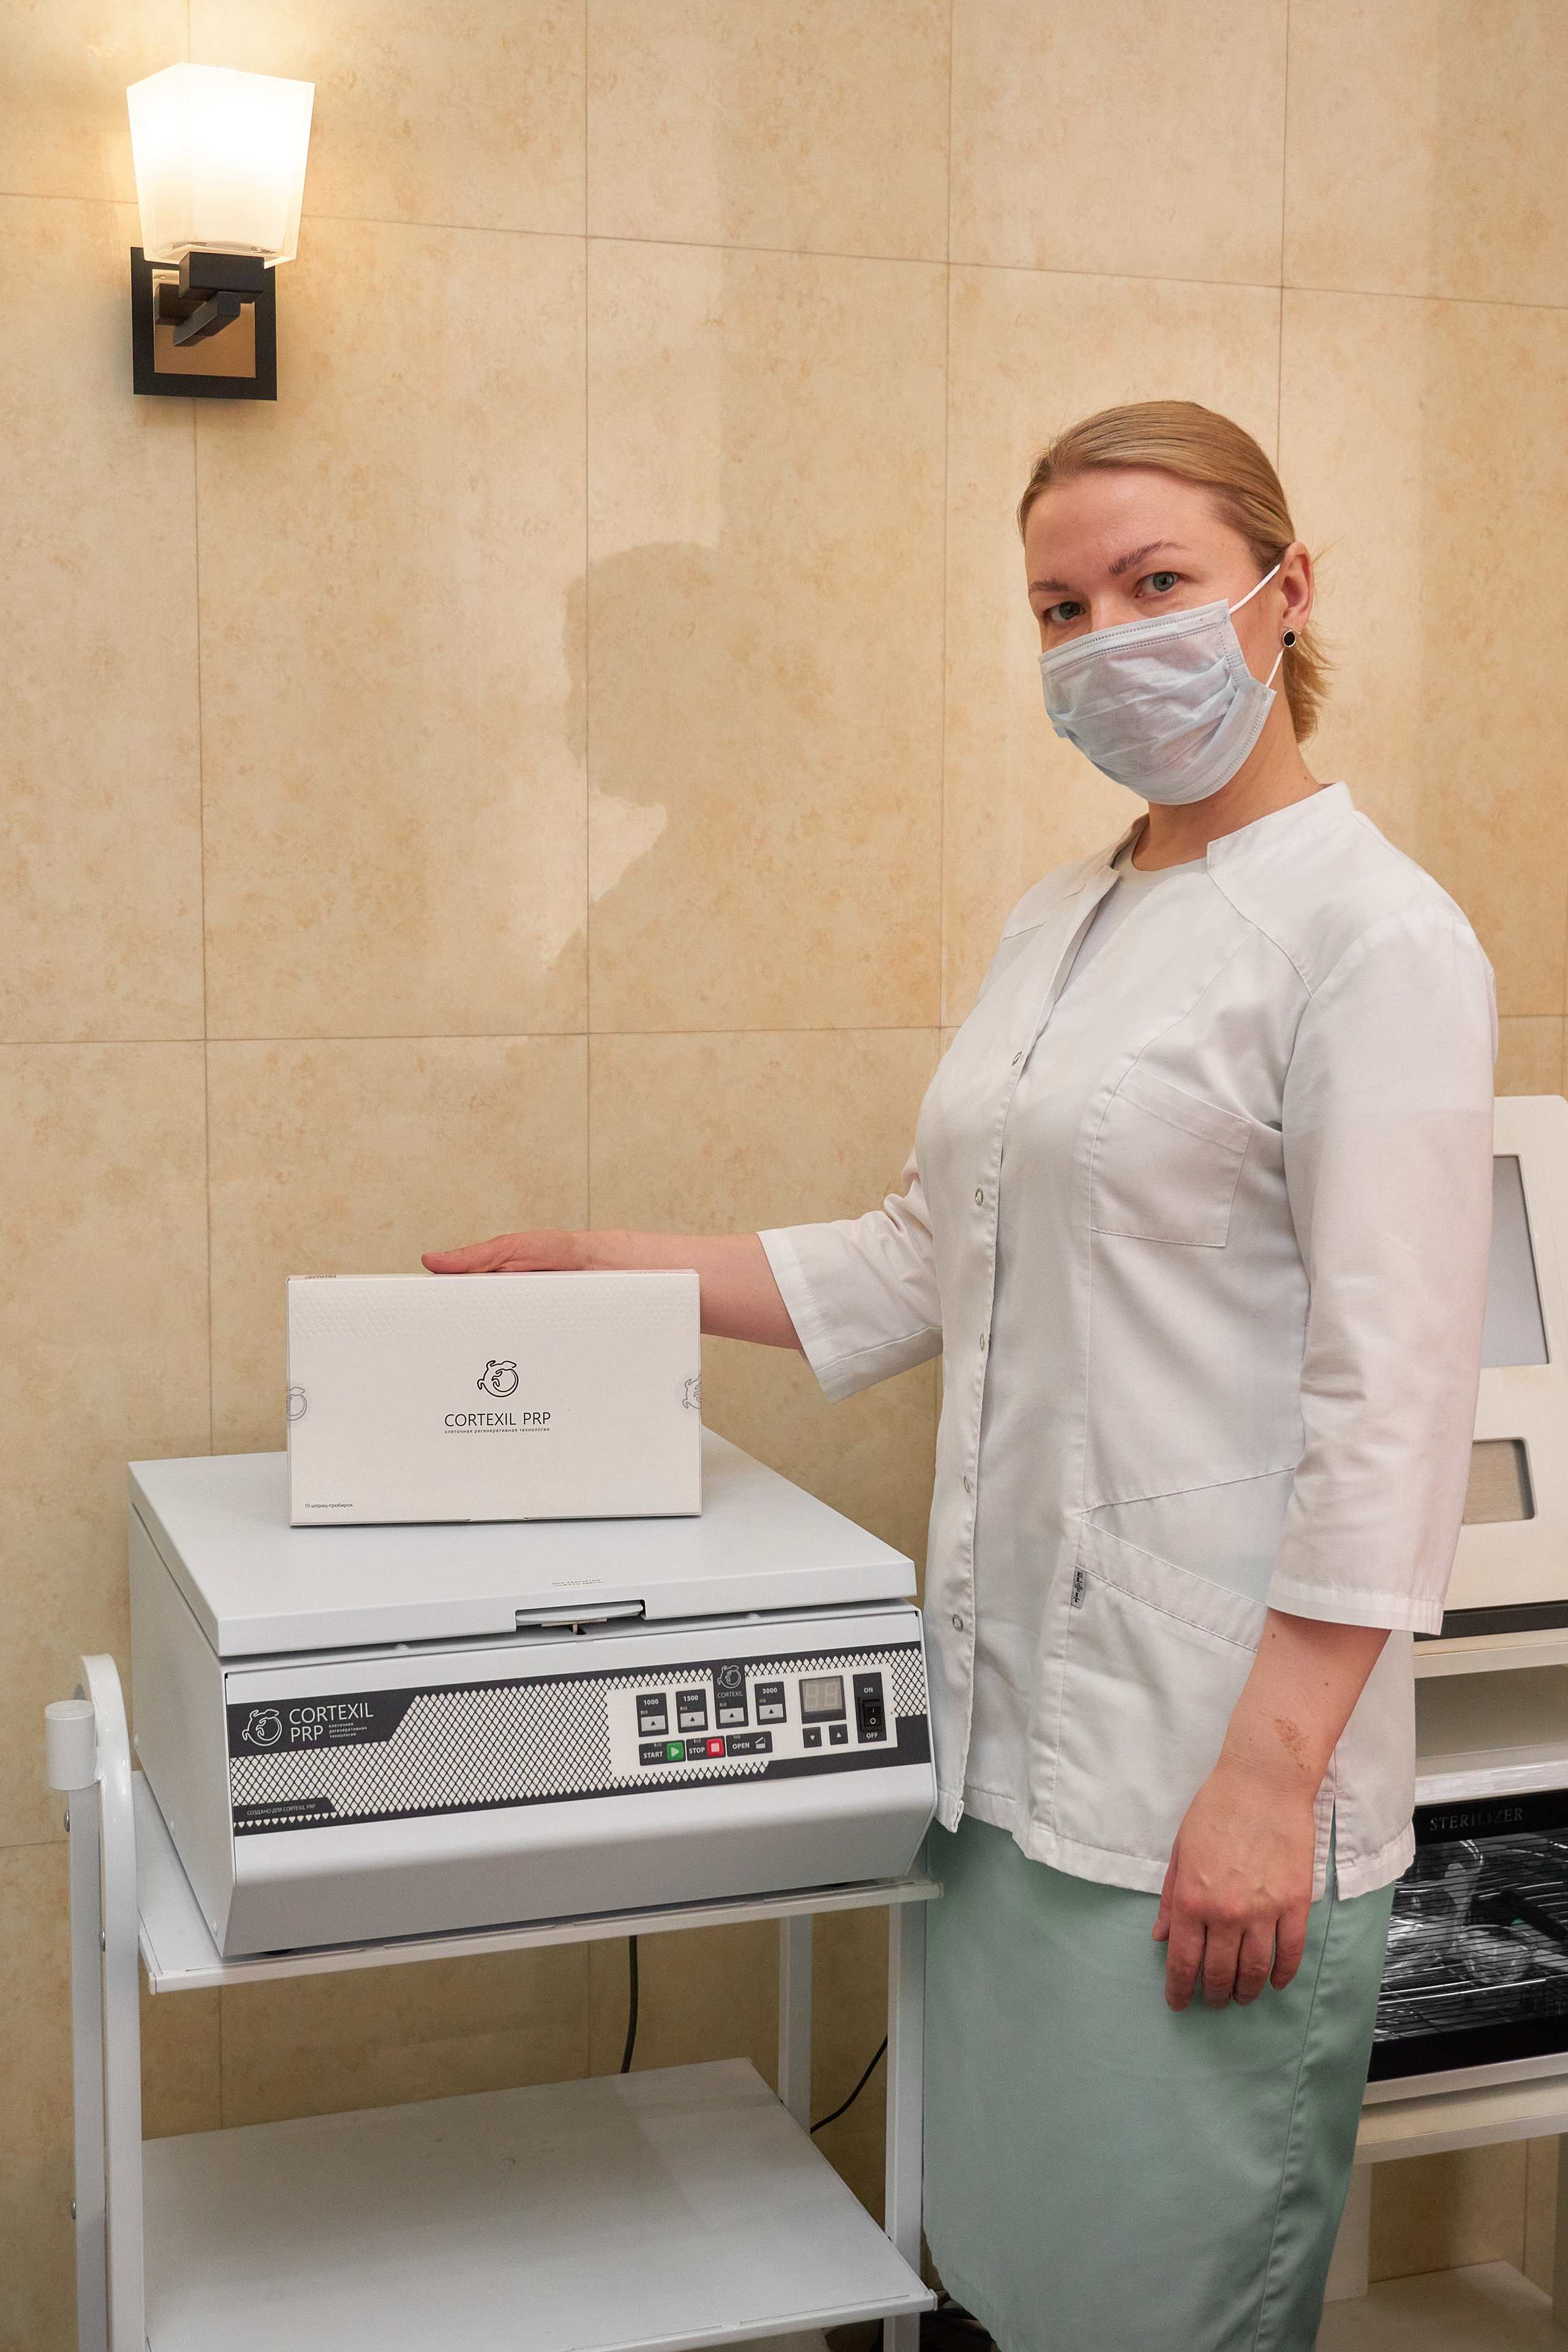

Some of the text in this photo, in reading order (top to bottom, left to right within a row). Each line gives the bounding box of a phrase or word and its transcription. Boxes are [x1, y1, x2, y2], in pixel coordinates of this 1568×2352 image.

[444, 1412, 551, 1427] CORTEXIL PRP
[717, 1691, 744, 1699] CORTEXIL
[289, 1702, 374, 1725] CORTEXIL
[290, 1725, 323, 1743] PRP
[732, 1741, 750, 1750] OPEN
[643, 1751, 663, 1759] START
[1430, 1807, 1524, 1831] STERILIZER
